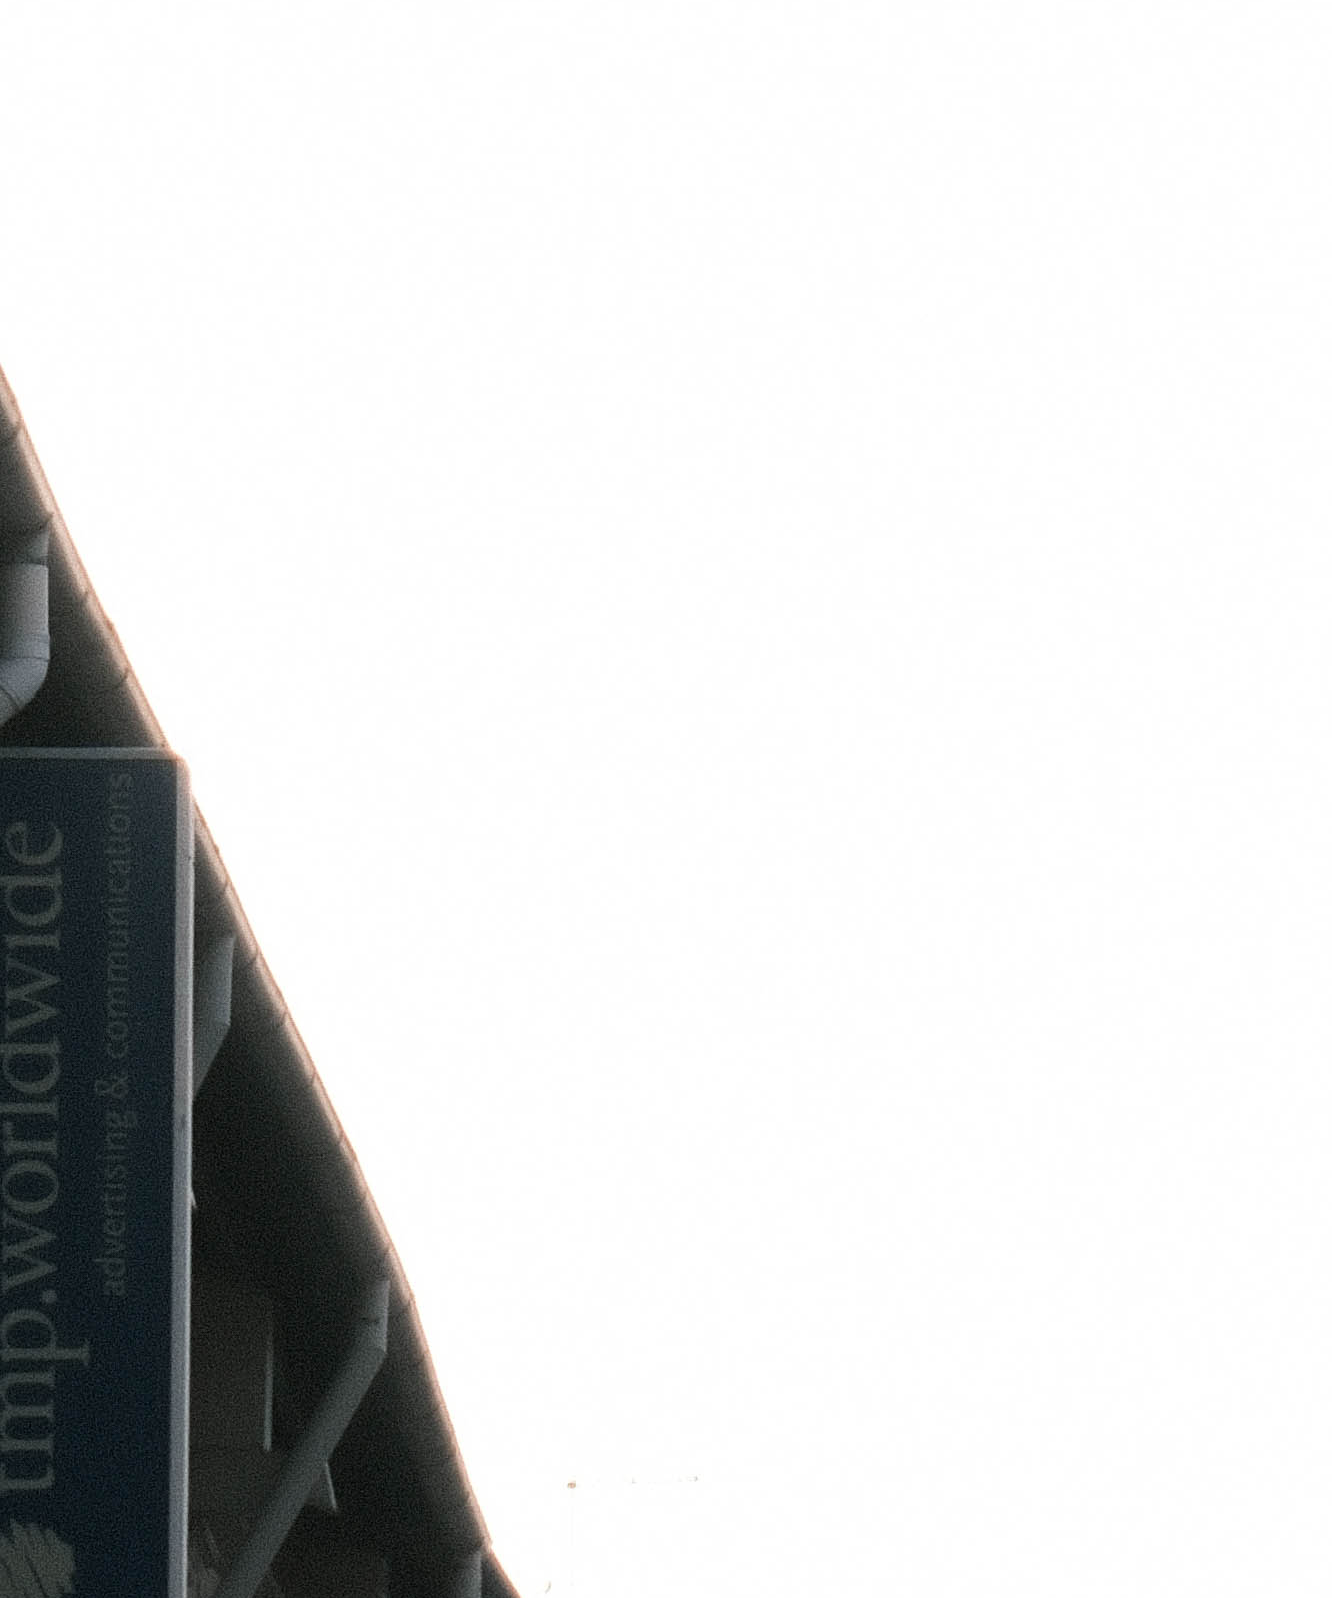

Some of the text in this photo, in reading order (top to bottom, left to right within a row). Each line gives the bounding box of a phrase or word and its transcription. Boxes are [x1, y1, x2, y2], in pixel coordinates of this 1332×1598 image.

[97, 771, 142, 1297] advertising & communications
